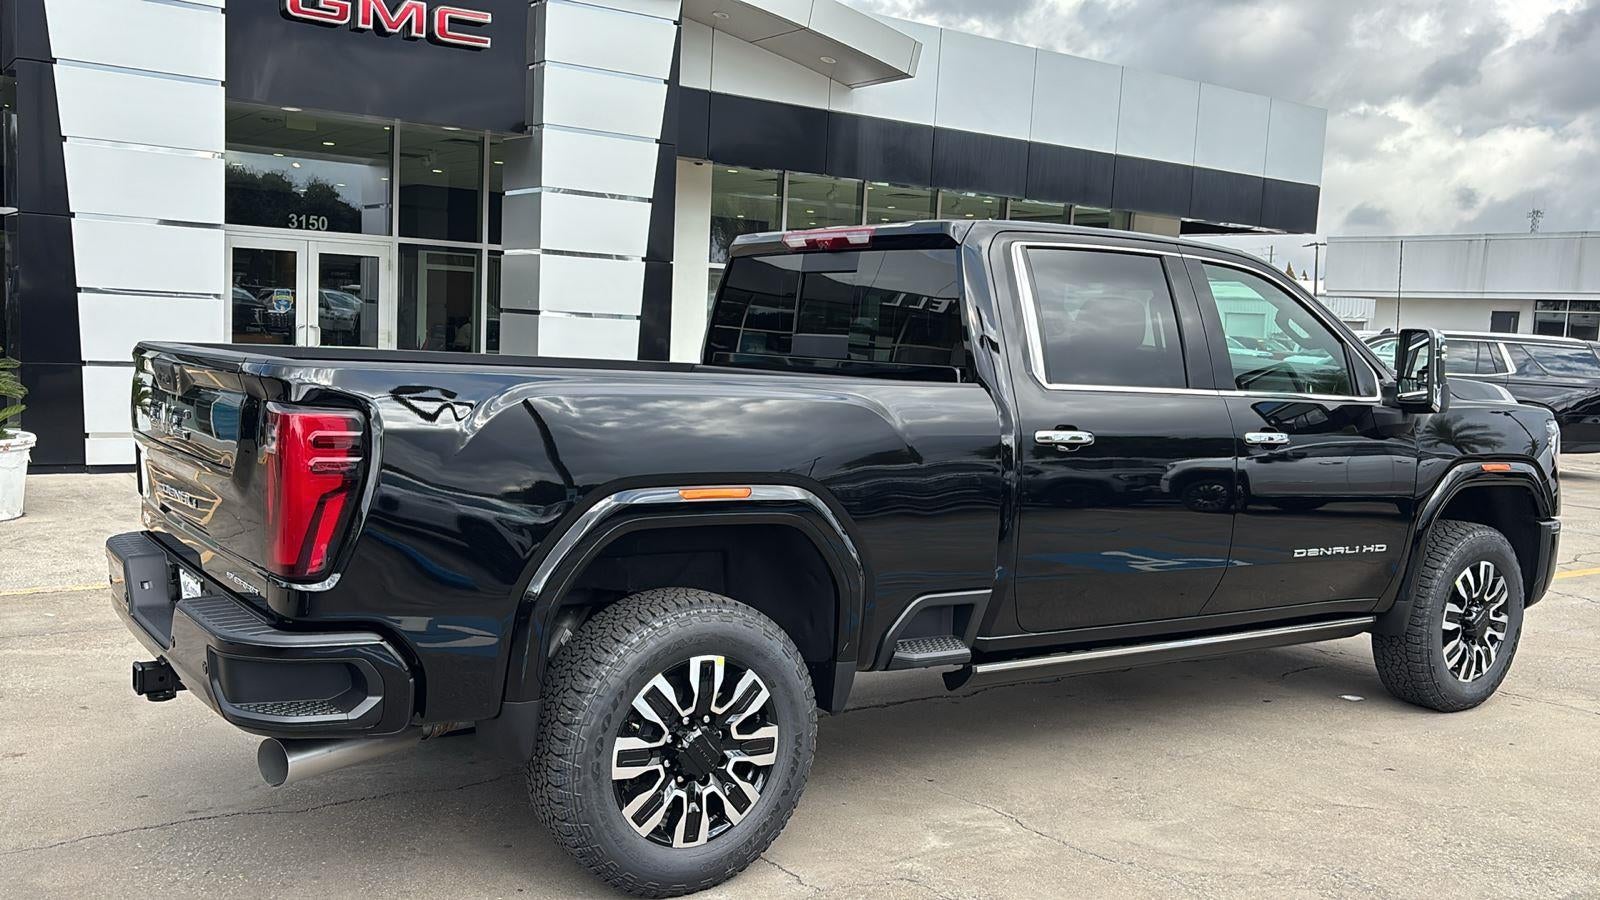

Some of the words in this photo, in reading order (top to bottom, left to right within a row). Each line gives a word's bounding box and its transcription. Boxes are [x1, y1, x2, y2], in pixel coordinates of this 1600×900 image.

[283, 0, 492, 49] GMC
[288, 213, 328, 231] 3150
[162, 484, 198, 509] DENALI
[1293, 545, 1360, 558] DENALI
[1361, 544, 1387, 553] HD
